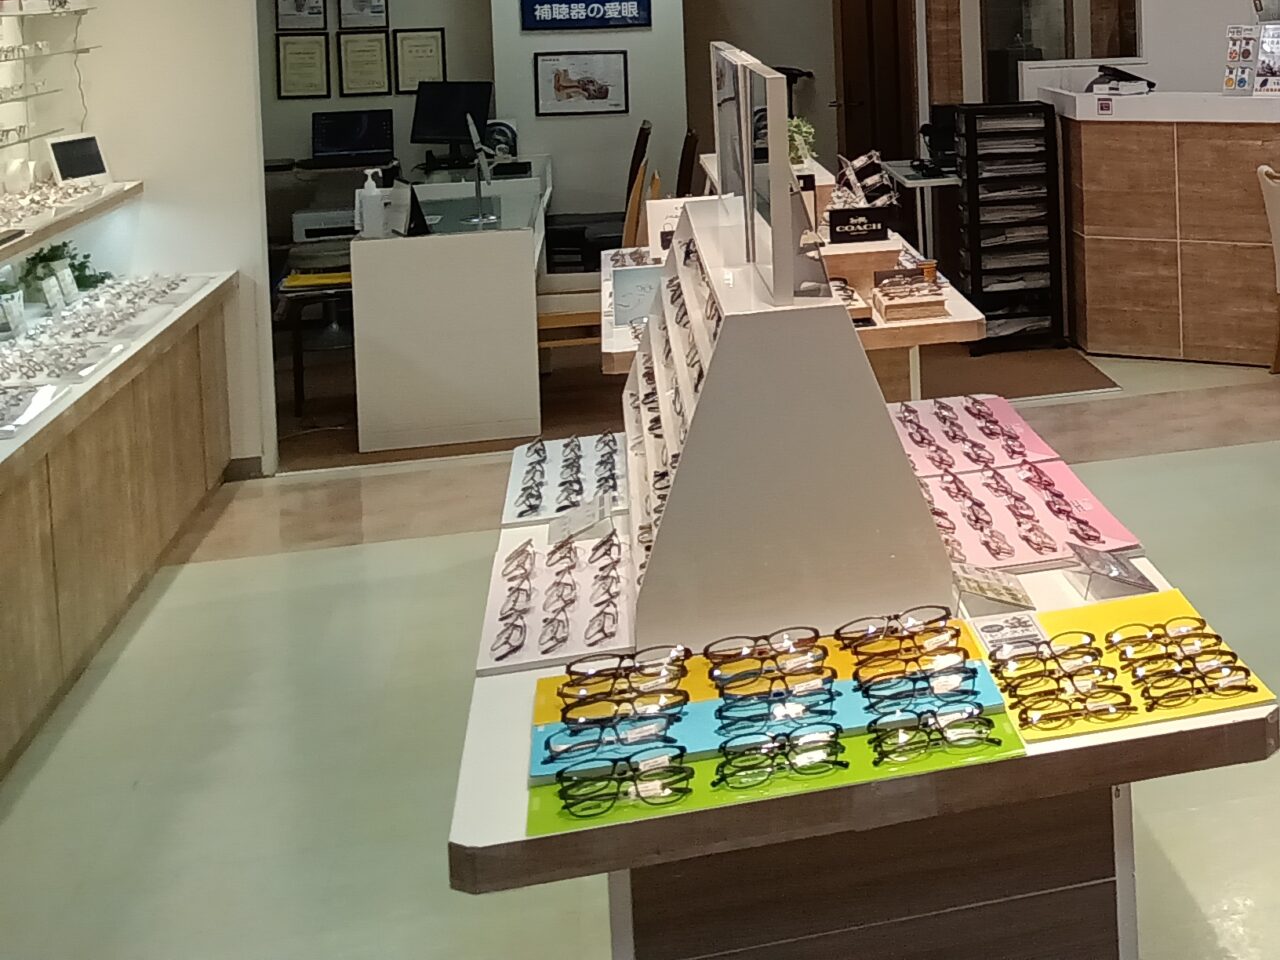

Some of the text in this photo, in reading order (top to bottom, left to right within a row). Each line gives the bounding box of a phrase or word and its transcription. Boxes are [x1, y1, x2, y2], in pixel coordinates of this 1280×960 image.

[533, 1, 640, 21] 補聴器の愛眼
[835, 223, 882, 232] COACH
